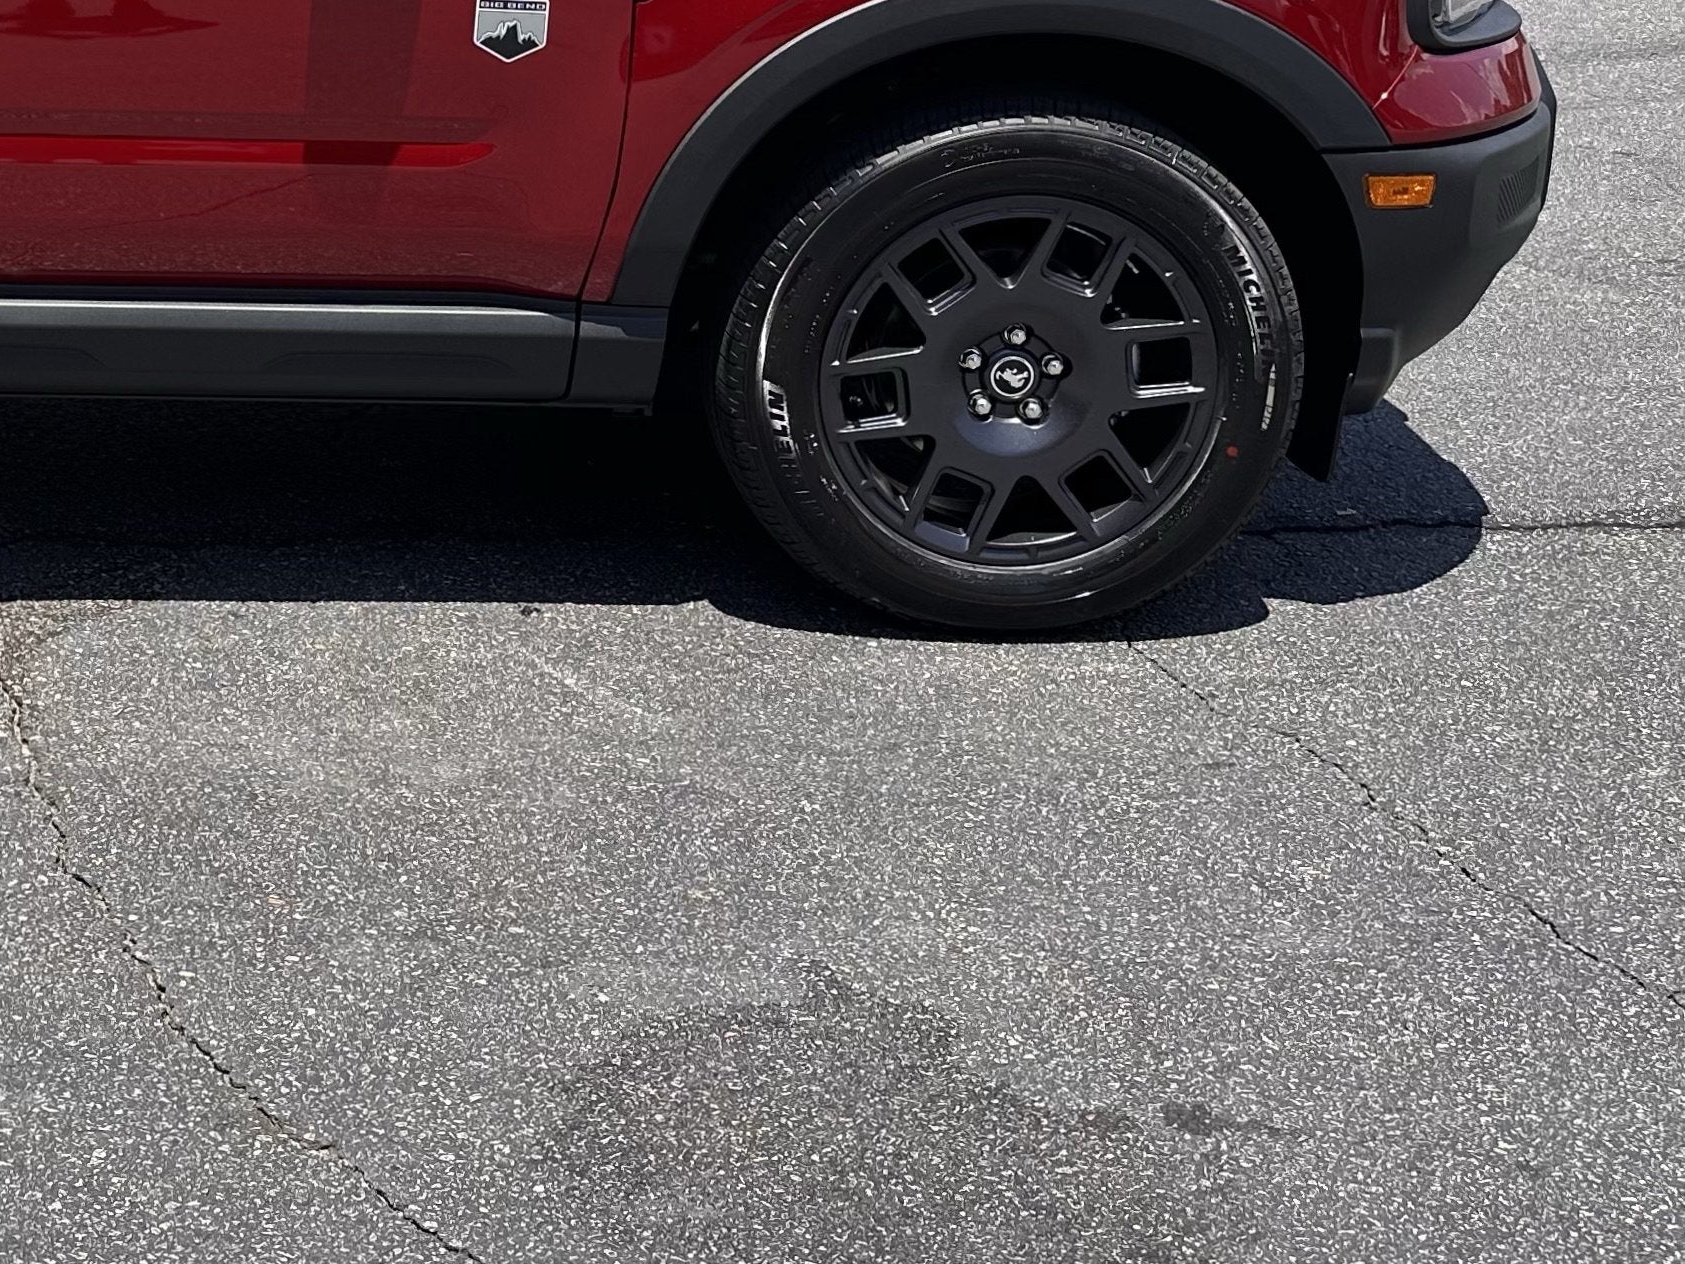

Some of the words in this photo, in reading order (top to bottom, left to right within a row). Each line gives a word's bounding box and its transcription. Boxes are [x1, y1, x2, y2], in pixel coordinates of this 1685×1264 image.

[480, 0, 504, 8] BIG
[507, 2, 546, 10] BEND
[1222, 244, 1276, 376] MICHELIN
